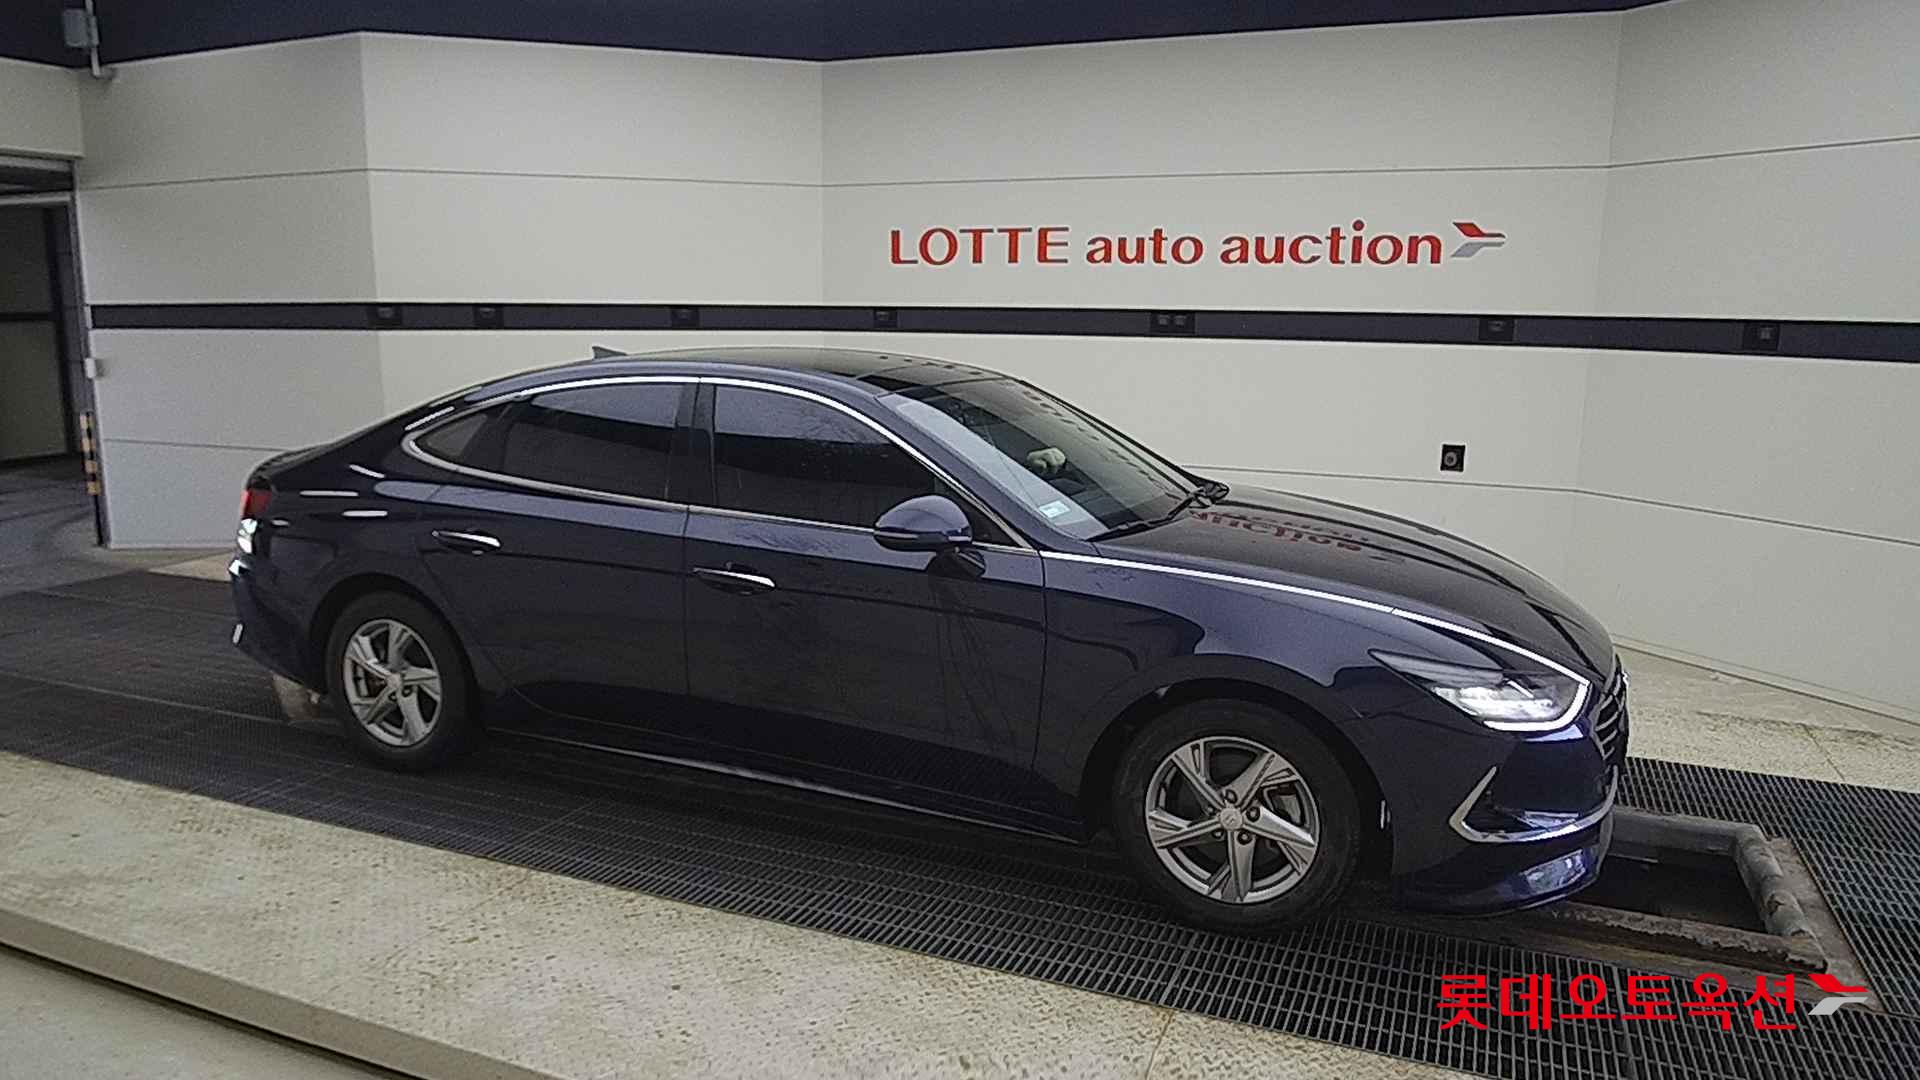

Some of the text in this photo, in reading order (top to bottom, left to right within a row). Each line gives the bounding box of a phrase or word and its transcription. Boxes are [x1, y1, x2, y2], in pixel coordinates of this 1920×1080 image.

[890, 219, 1443, 266] LOTTE auto auction
